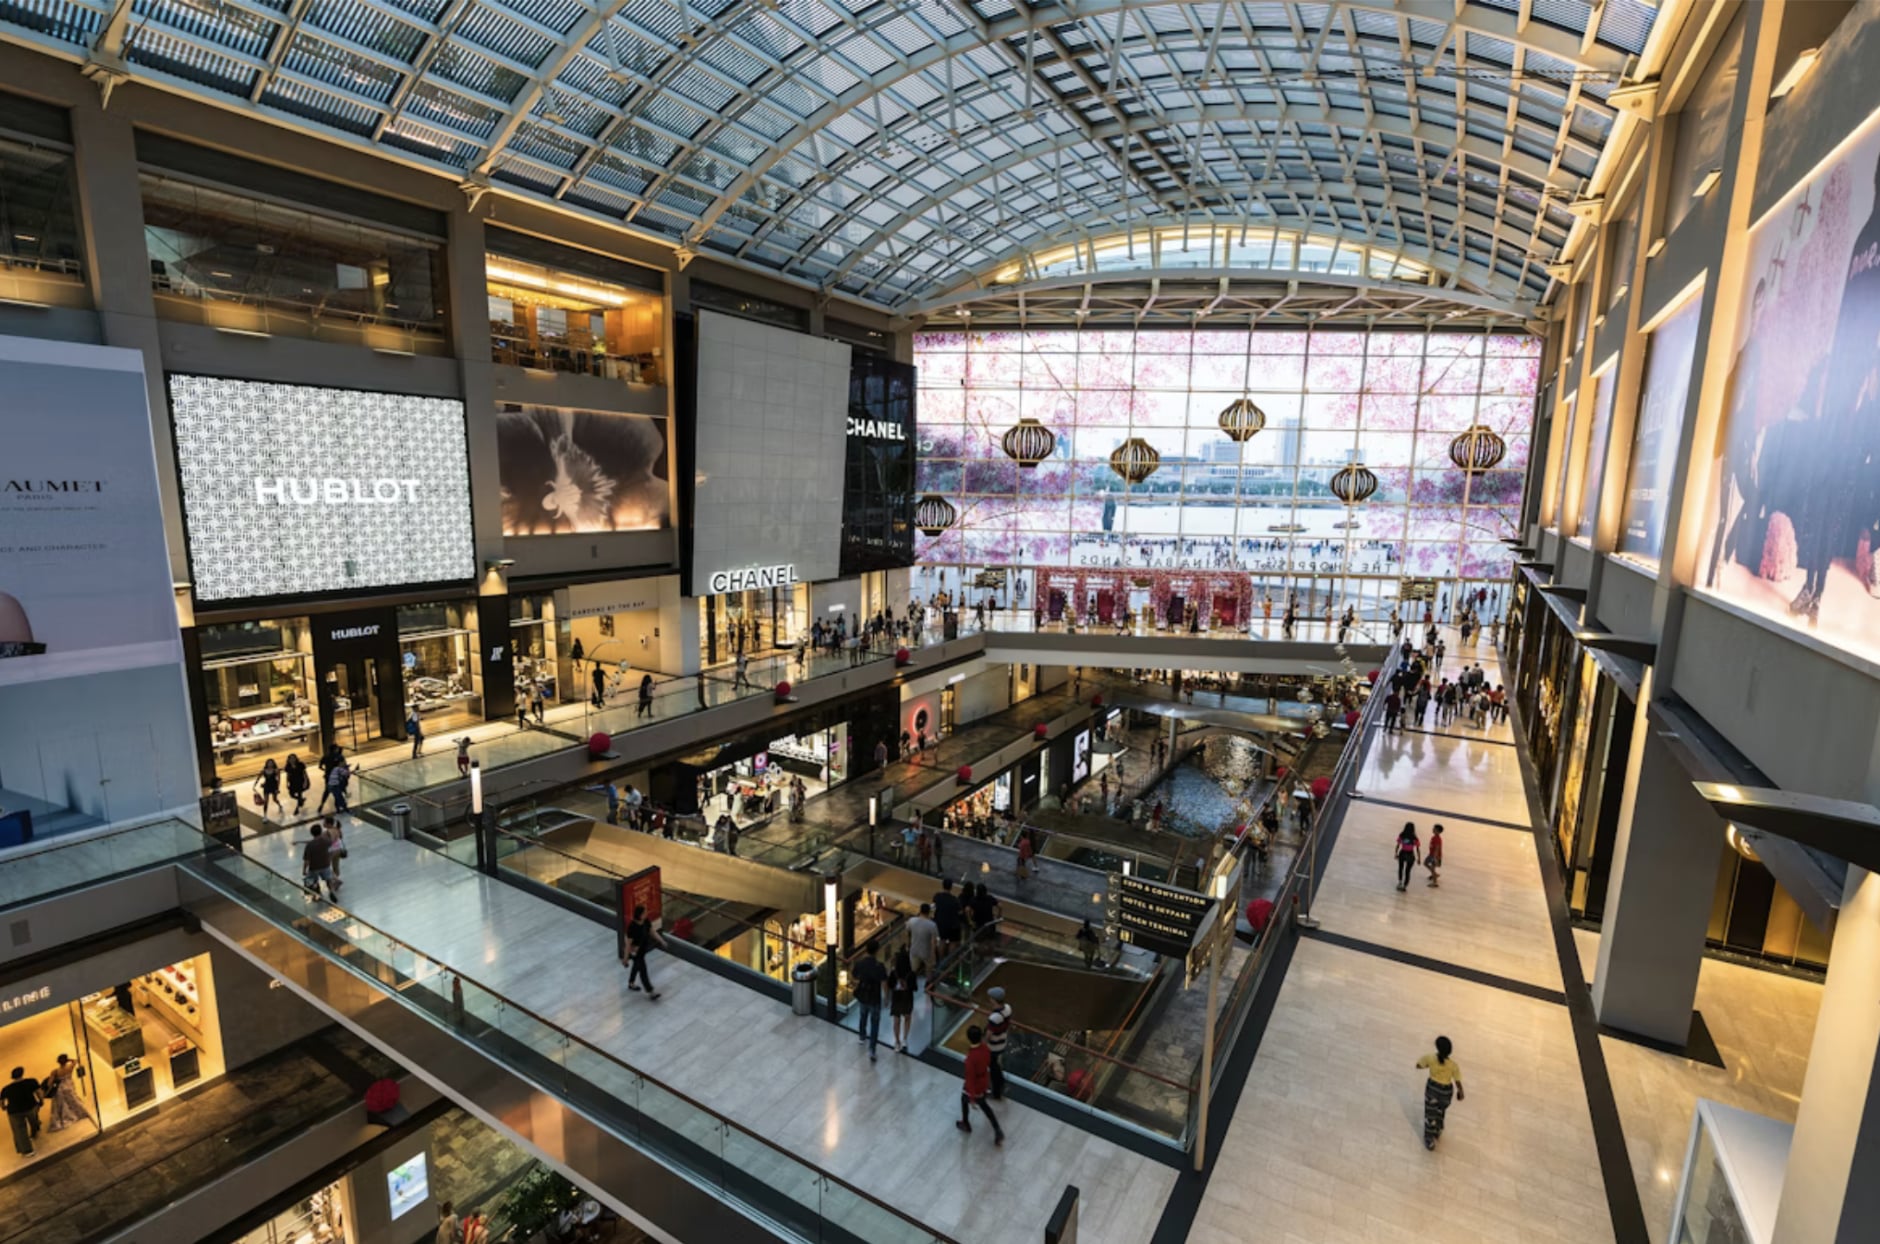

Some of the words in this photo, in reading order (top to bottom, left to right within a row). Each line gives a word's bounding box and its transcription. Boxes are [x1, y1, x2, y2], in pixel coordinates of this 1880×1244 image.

[846, 417, 905, 440] CHANEL
[254, 477, 420, 504] HUBLOT
[712, 565, 798, 593] CHANEL
[331, 624, 380, 640] HUBLOT
[1122, 879, 1144, 890] EXPO
[1151, 887, 1206, 905] CONVENTION
[1122, 897, 1147, 909] HOTEL
[1155, 905, 1192, 920] SKYPARK
[1121, 913, 1147, 926] COACH
[1149, 920, 1188, 937] TERMINAL
